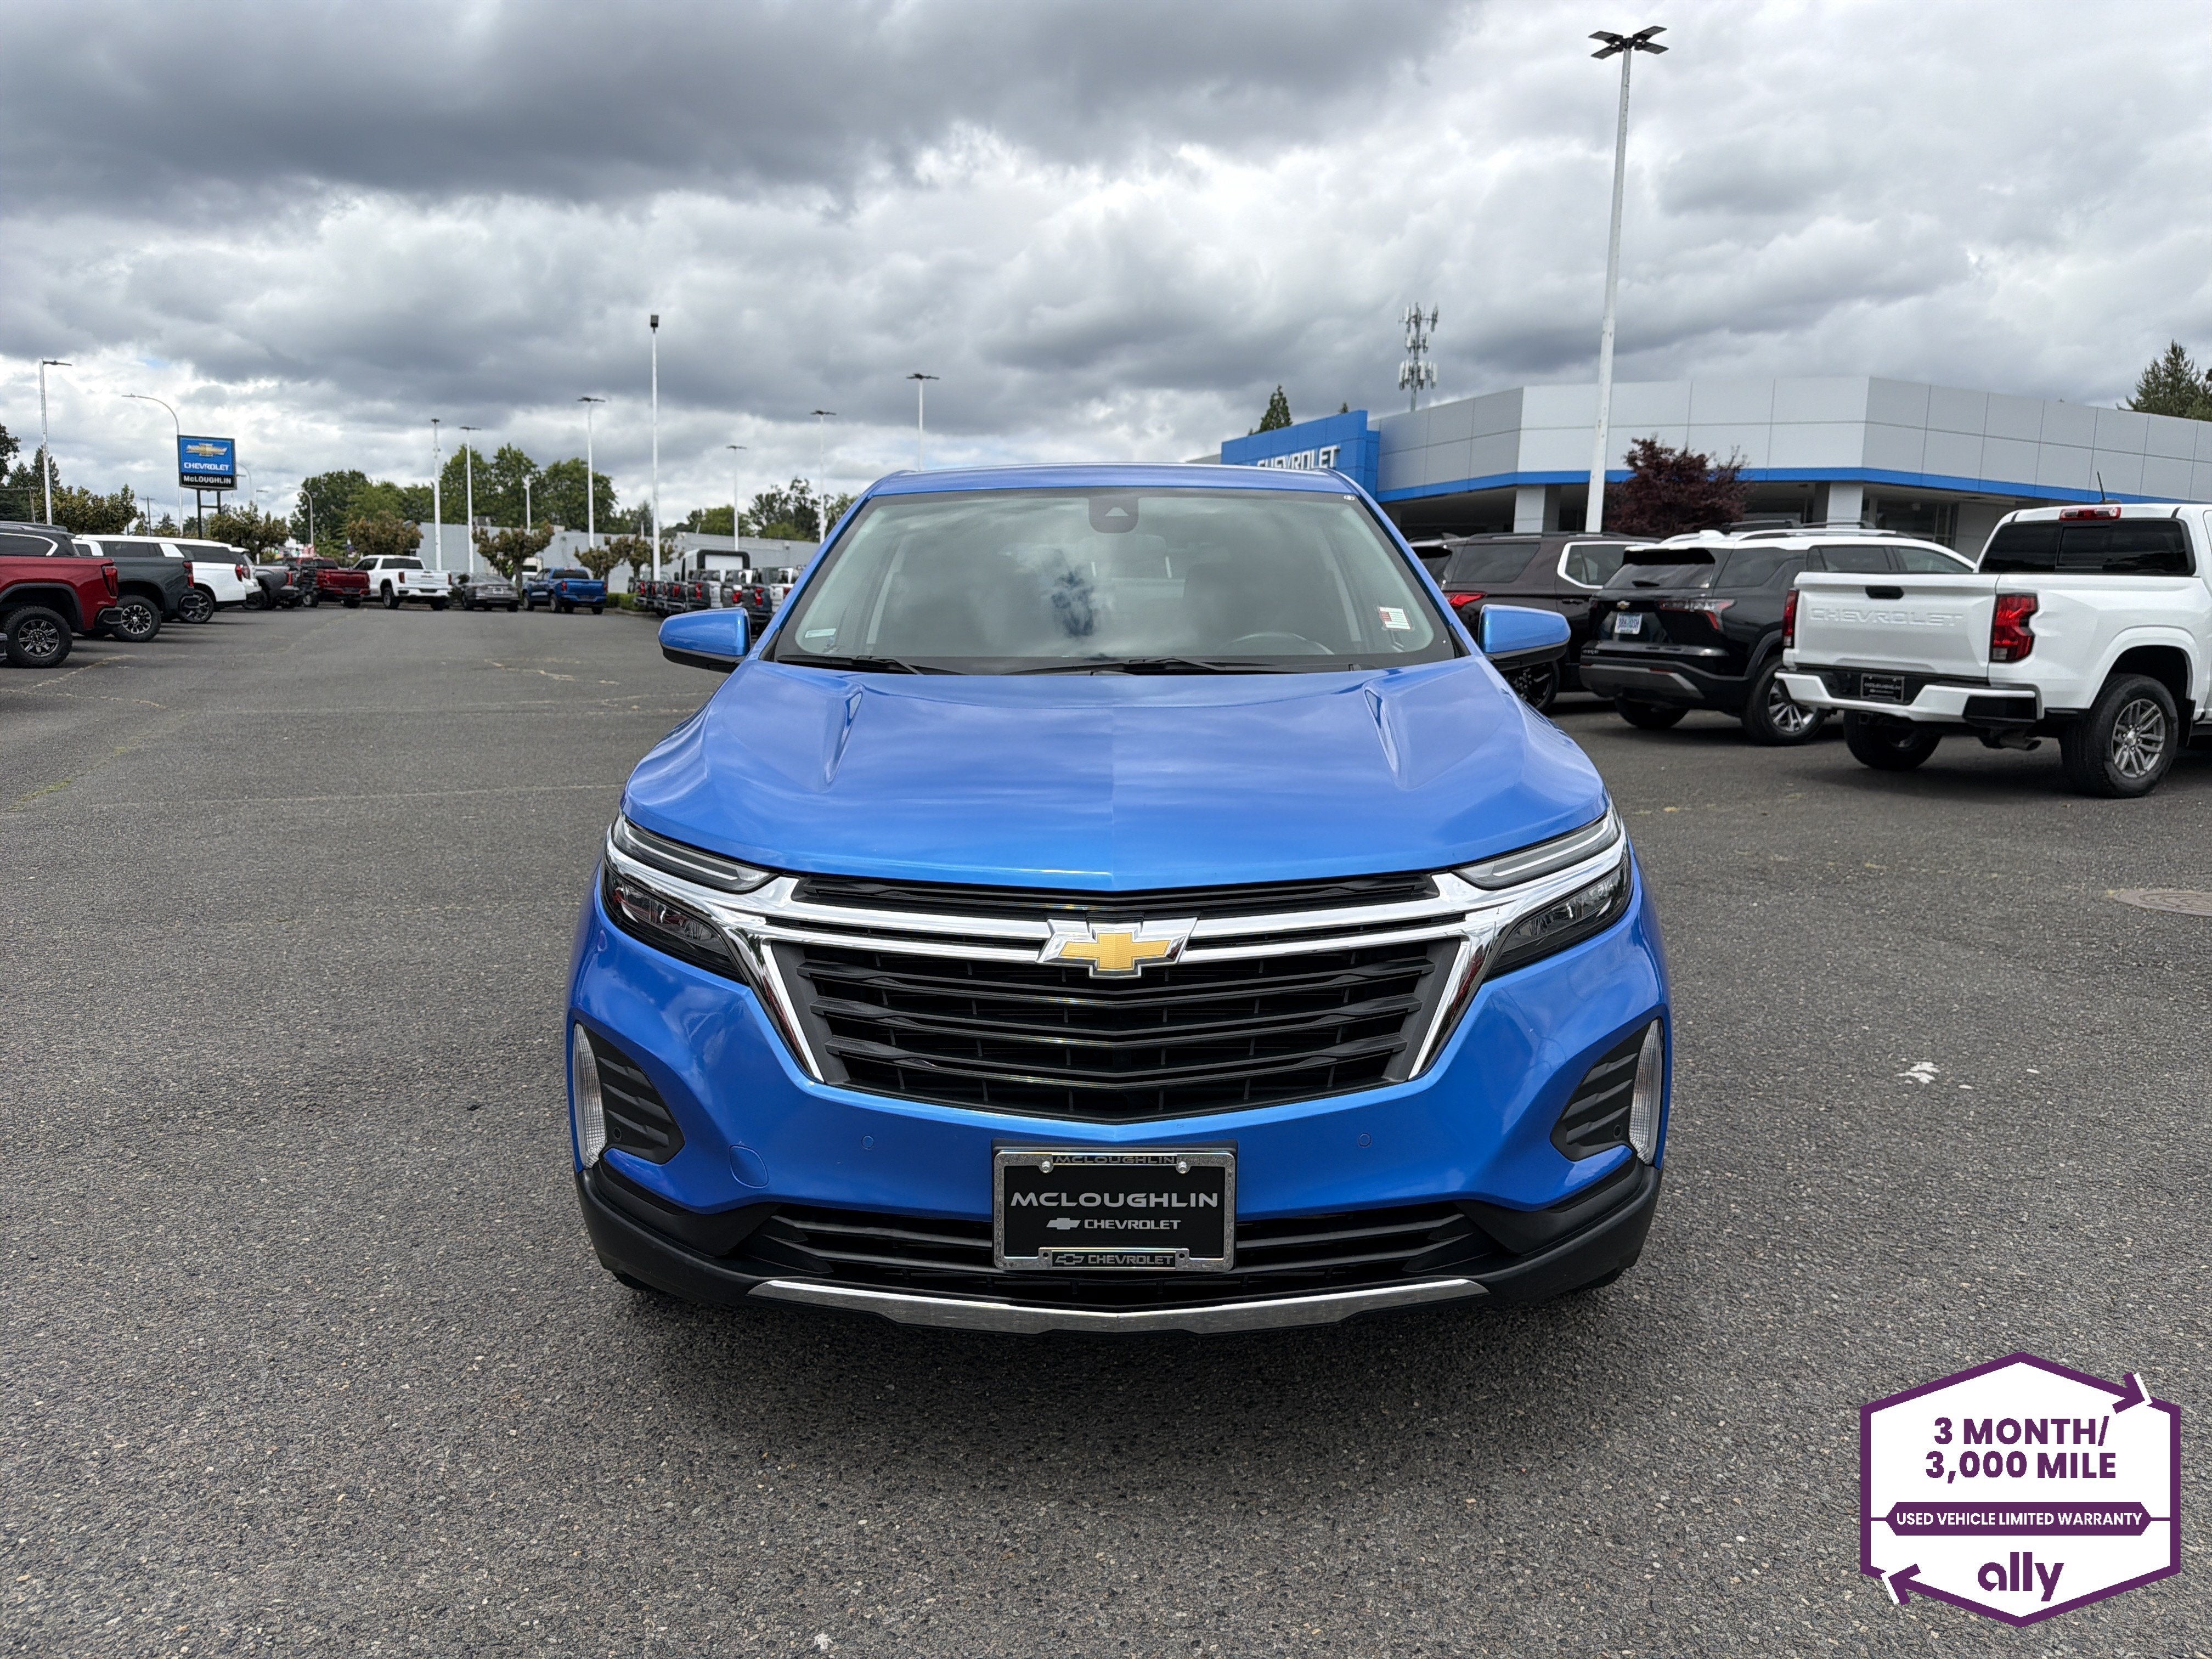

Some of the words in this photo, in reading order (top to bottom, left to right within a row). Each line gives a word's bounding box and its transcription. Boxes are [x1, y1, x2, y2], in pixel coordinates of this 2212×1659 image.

[1257, 445, 1340, 469] EVROLET
[183, 462, 229, 471] CHEVROLET
[183, 475, 232, 484] McLOUGHLIN
[1810, 608, 1963, 626] CHEVROLET
[1011, 1192, 1218, 1207] MCLOUGHLIN
[1084, 1219, 1181, 1229] CHEVROLET
[1088, 1255, 1173, 1265] CHEVROLET
